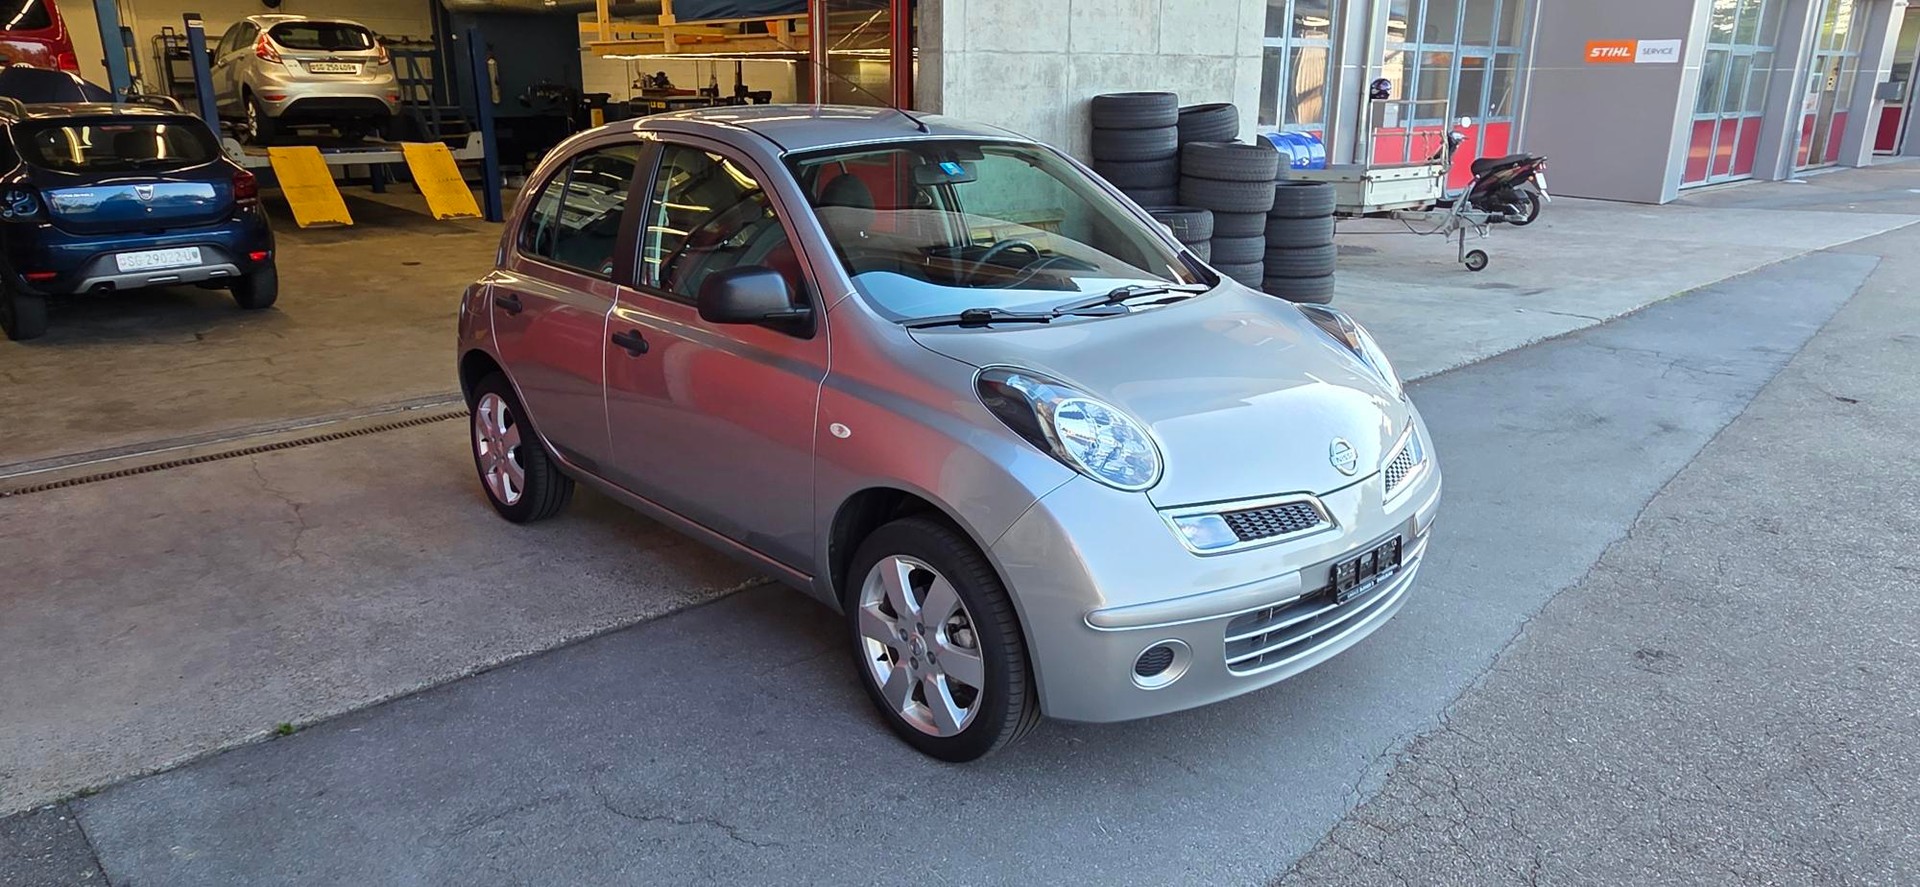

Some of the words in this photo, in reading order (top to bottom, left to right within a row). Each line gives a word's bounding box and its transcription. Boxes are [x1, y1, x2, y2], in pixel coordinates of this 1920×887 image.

[1590, 47, 1631, 57] STIHL
[1642, 47, 1674, 55] SERVICE
[127, 254, 143, 267] SG
